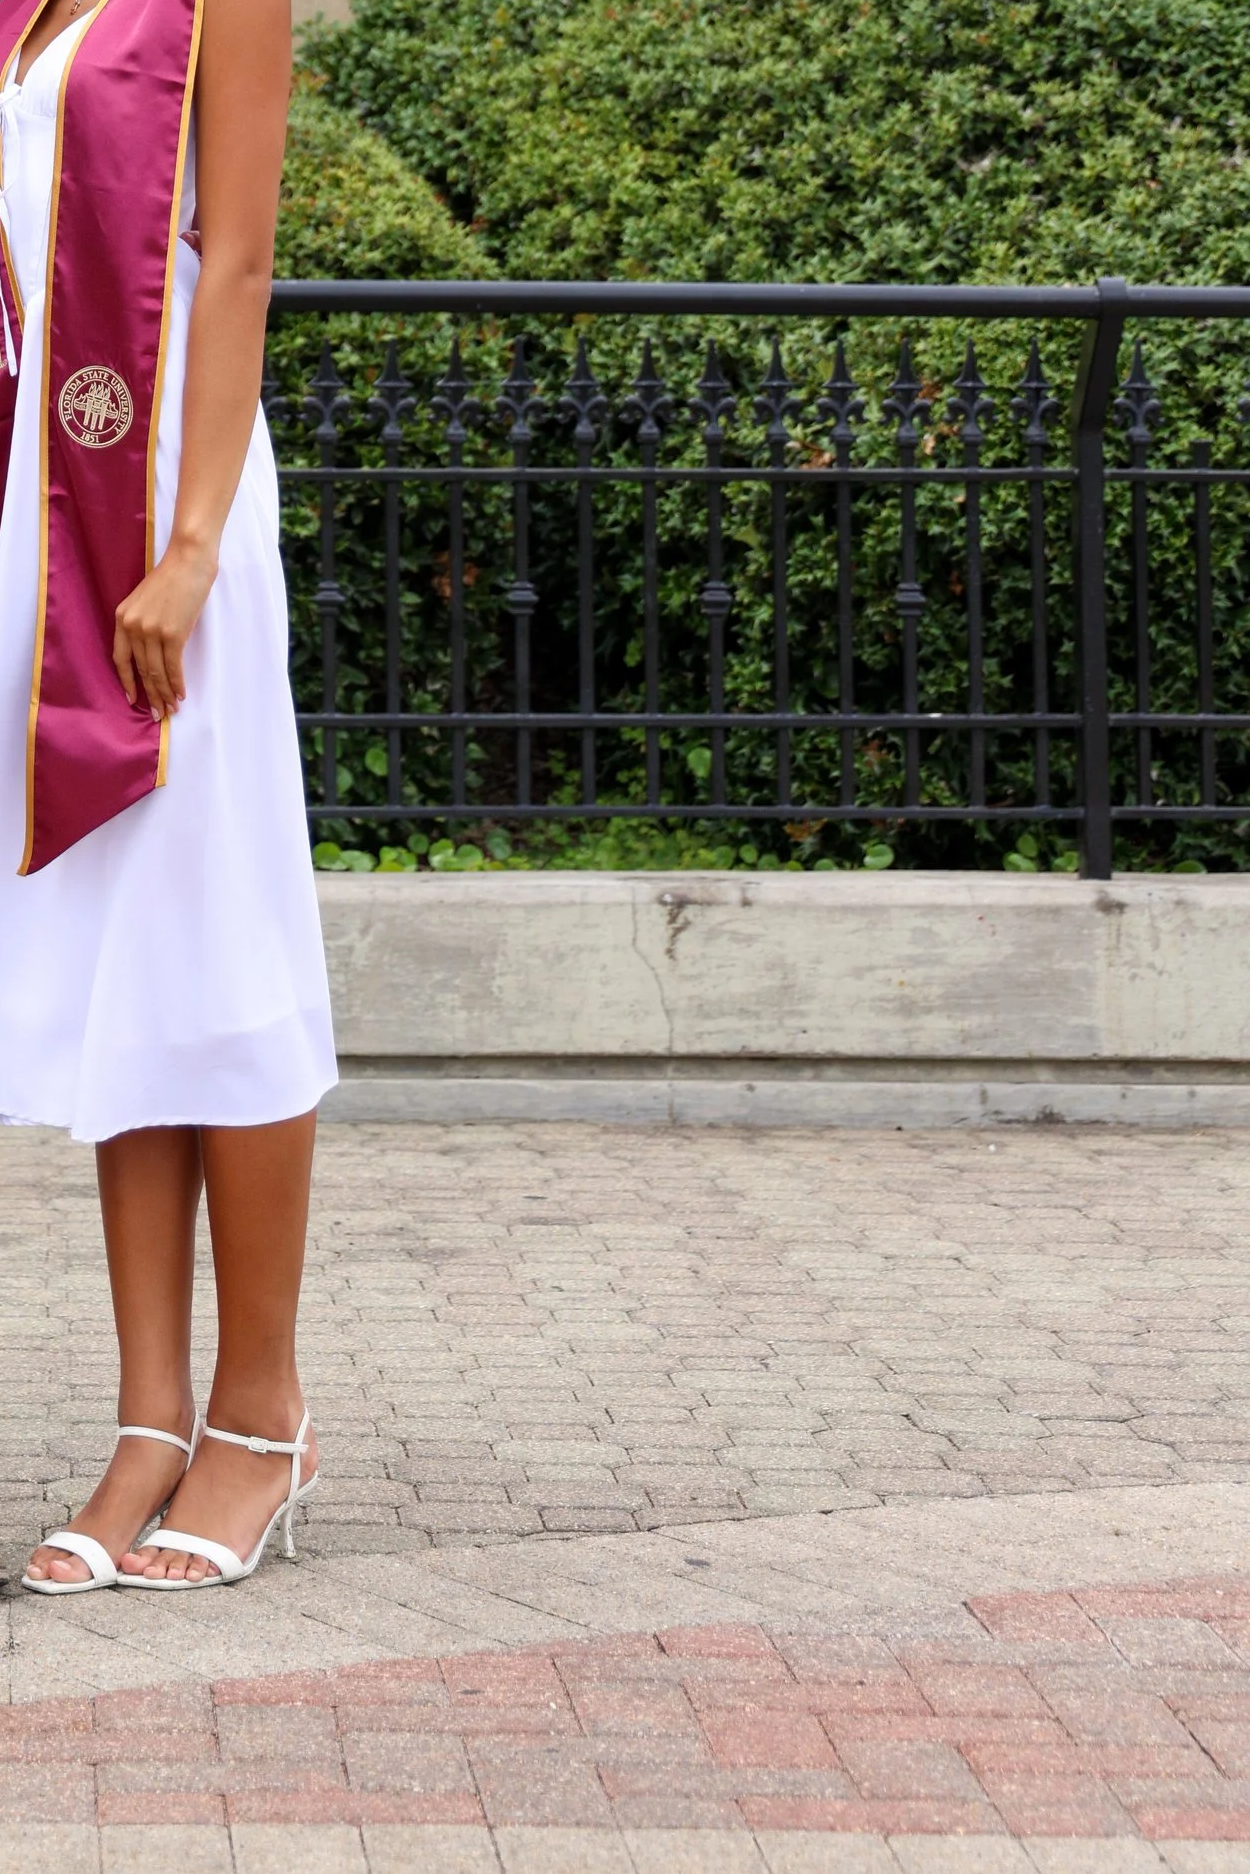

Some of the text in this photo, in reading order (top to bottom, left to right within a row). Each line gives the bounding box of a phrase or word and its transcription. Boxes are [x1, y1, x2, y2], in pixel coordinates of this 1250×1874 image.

[62, 370, 129, 434] FLORIDA STATE UNIVERSITY
[80, 431, 100, 443] 1851
